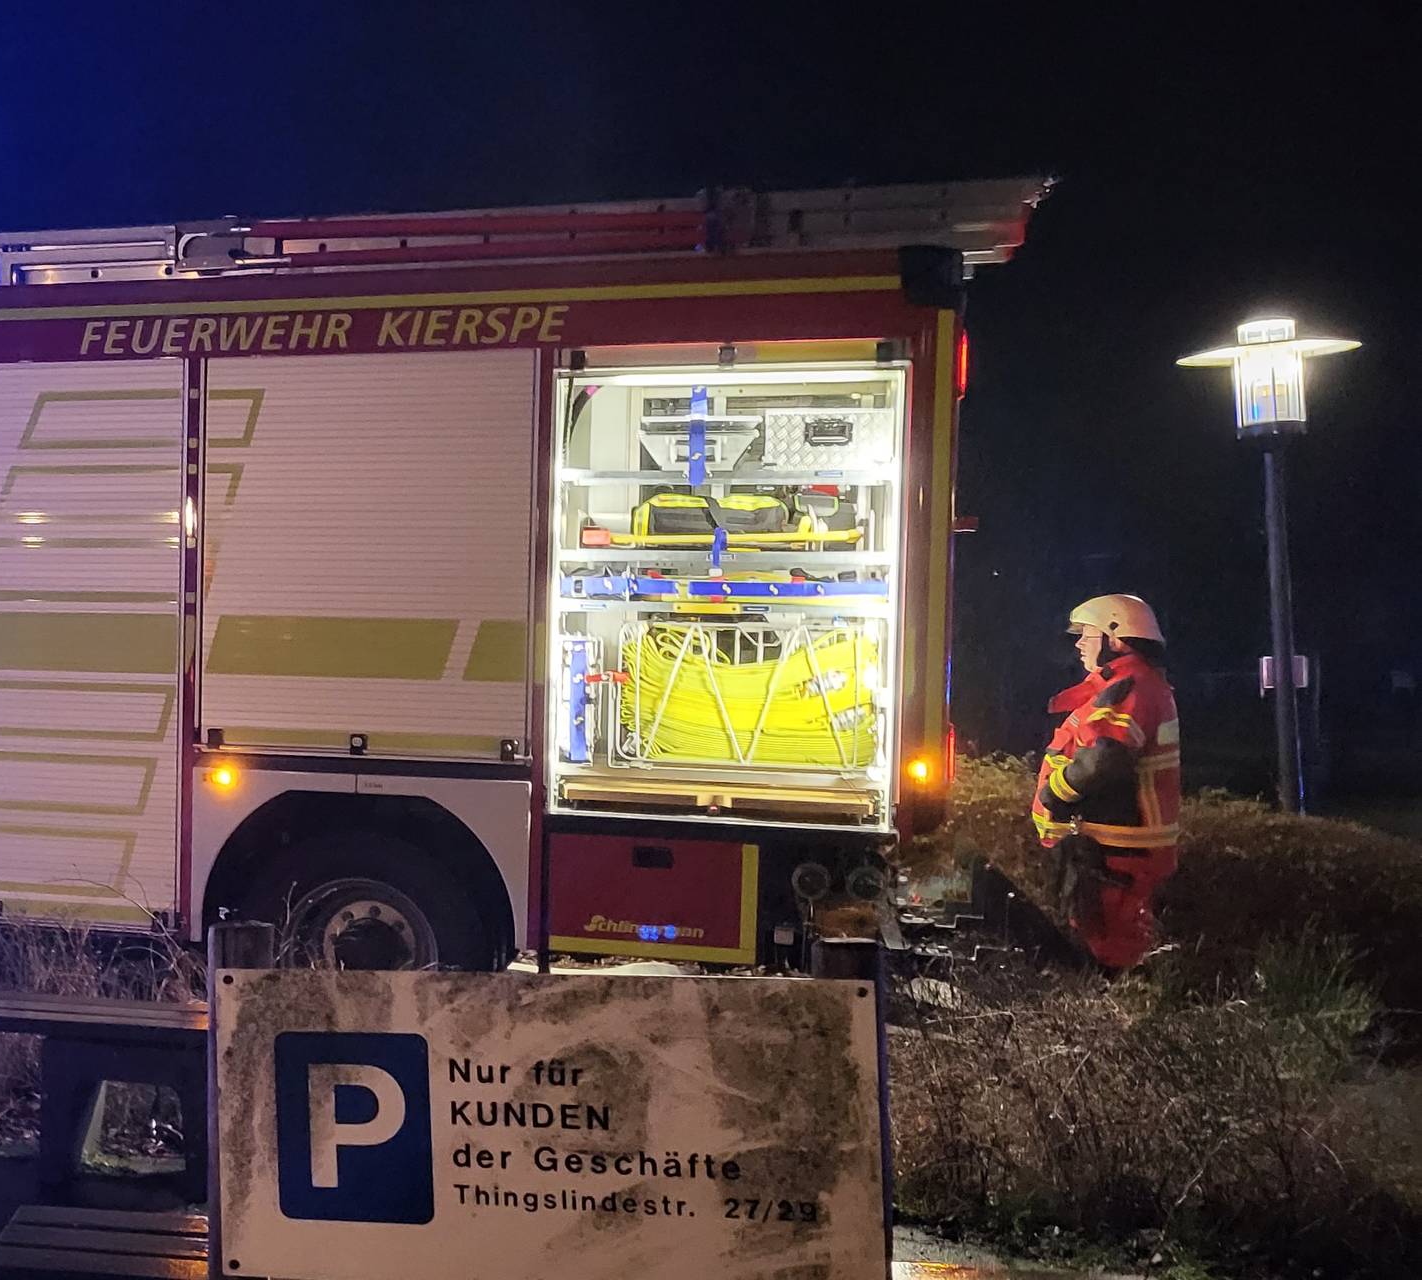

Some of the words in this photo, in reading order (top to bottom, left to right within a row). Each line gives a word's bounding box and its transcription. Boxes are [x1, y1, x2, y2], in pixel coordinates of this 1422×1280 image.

[79, 313, 354, 355] FEUERWEHR
[377, 304, 569, 347] KIERSPE
[583, 914, 706, 941] Schlinmnn
[448, 1058, 510, 1084] Nur
[532, 1060, 583, 1087] für
[308, 1063, 406, 1188] P
[450, 1101, 610, 1131] KUNDEN
[453, 1143, 512, 1170] der
[534, 1146, 741, 1181] Geschäfte
[453, 1184, 696, 1218] Thingslindestr.
[724, 1198, 818, 1224] 27/29
